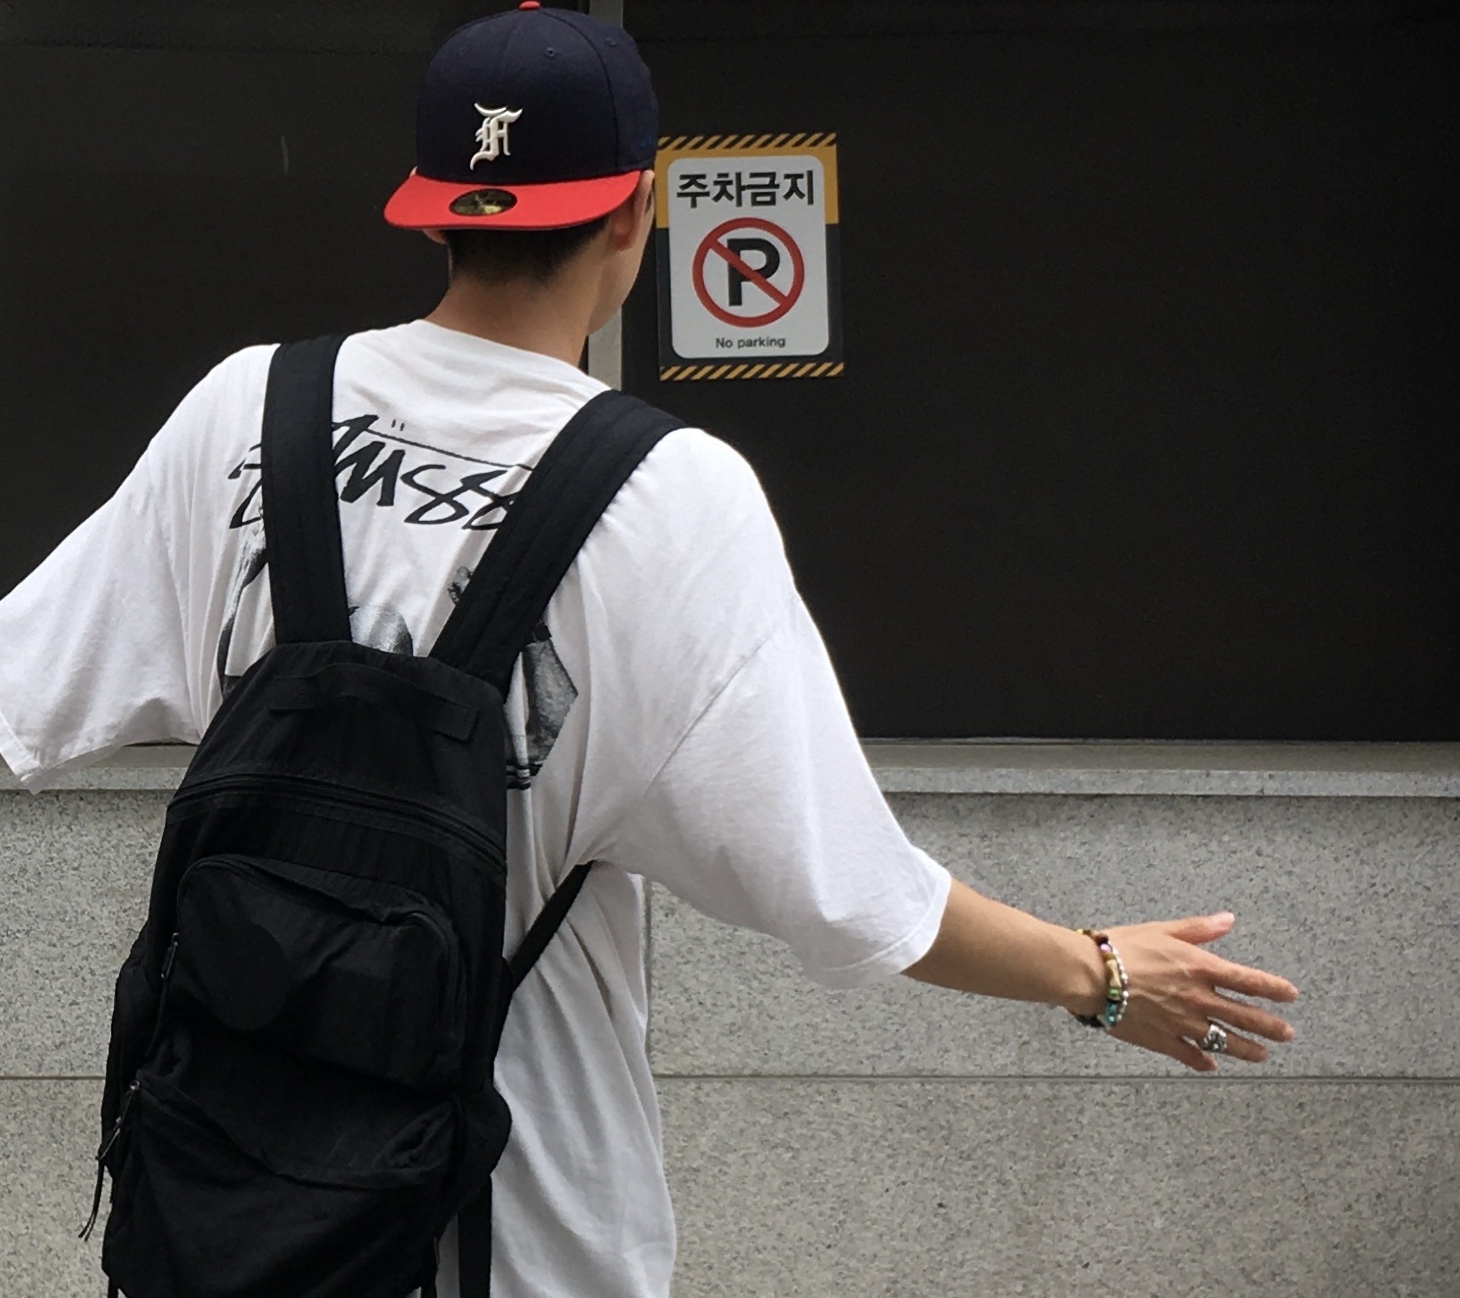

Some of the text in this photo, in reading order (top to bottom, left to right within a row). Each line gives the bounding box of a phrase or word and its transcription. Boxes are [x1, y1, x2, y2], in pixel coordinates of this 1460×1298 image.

[676, 170, 815, 209] 주차금지
[715, 336, 786, 350] No parking
